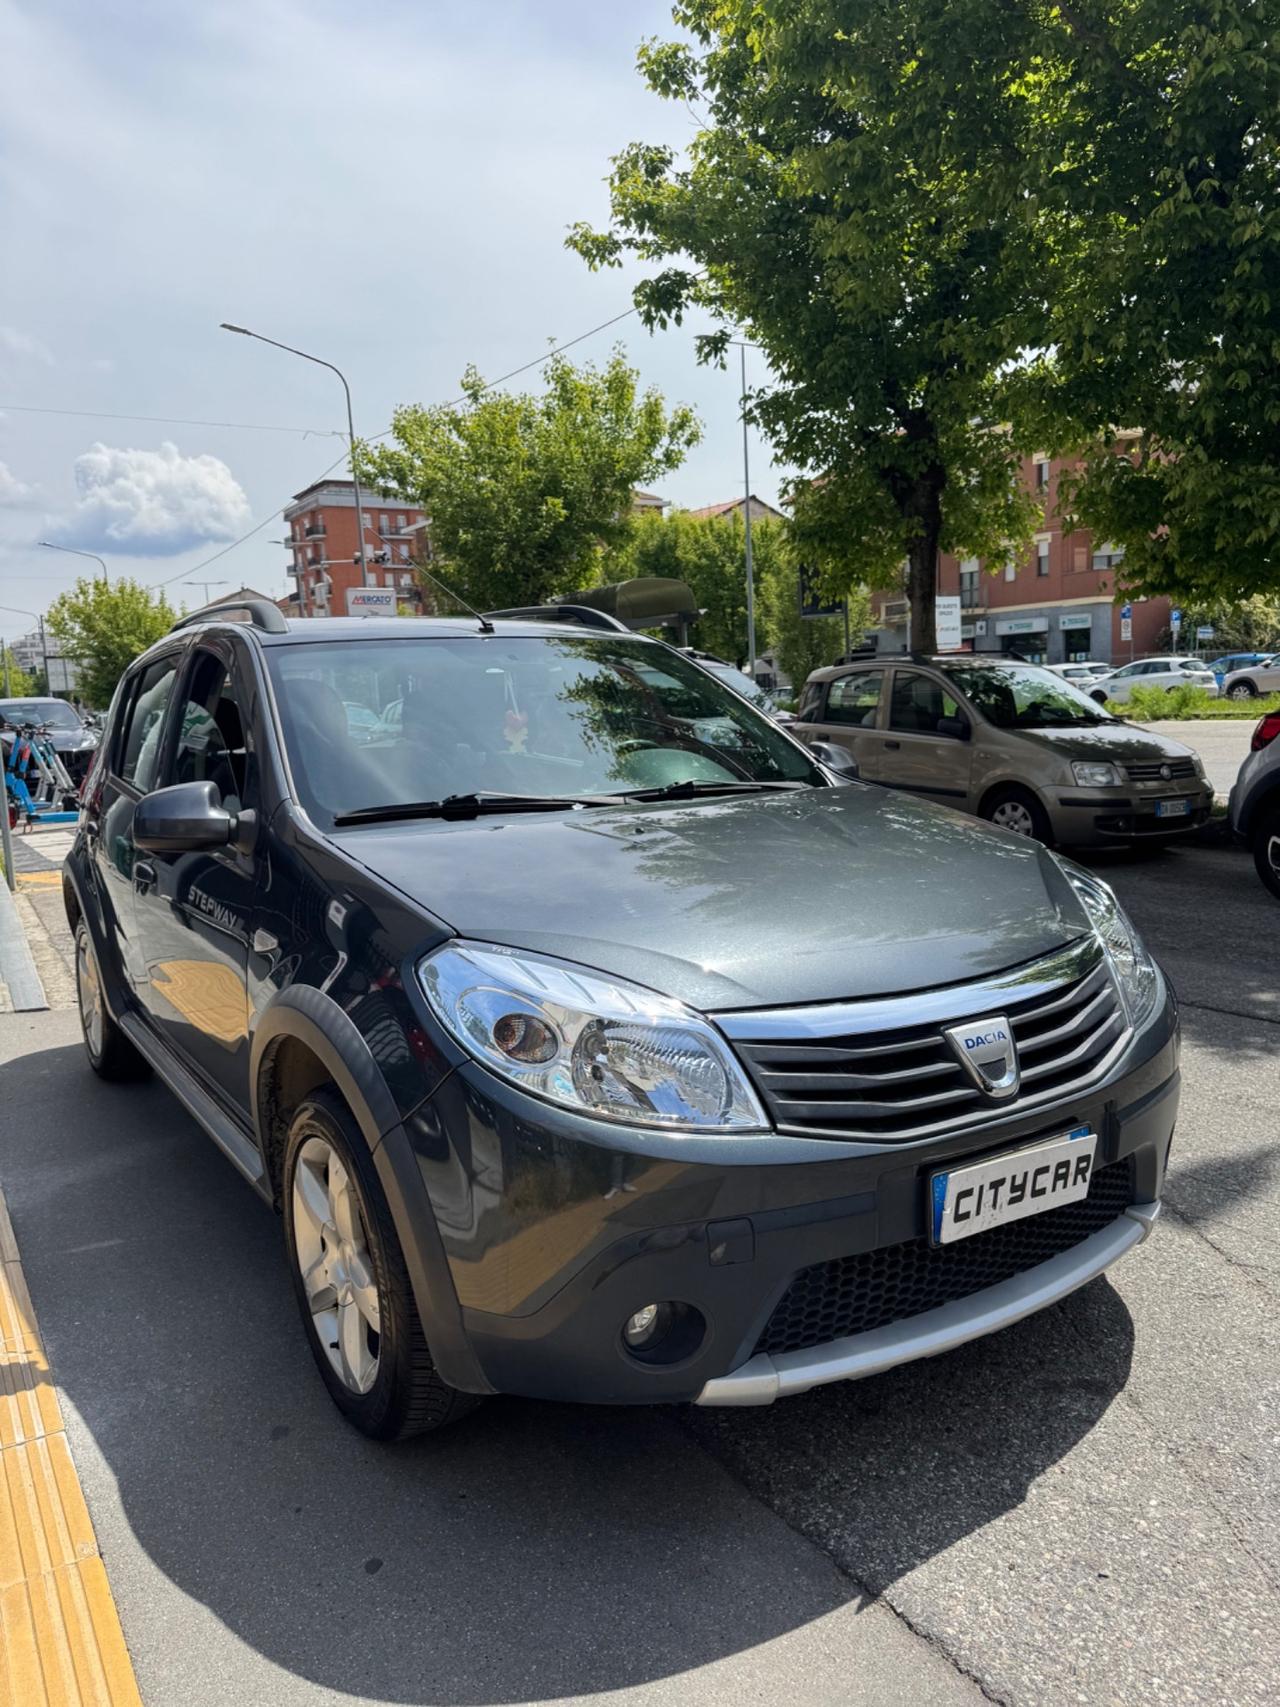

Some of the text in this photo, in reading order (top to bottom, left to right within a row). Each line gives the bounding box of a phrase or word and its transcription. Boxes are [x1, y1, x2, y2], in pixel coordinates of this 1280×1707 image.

[188, 885, 237, 929] STEPWAY
[964, 1029, 1007, 1050] DACIA
[953, 1153, 1092, 1224] CITYCAR
